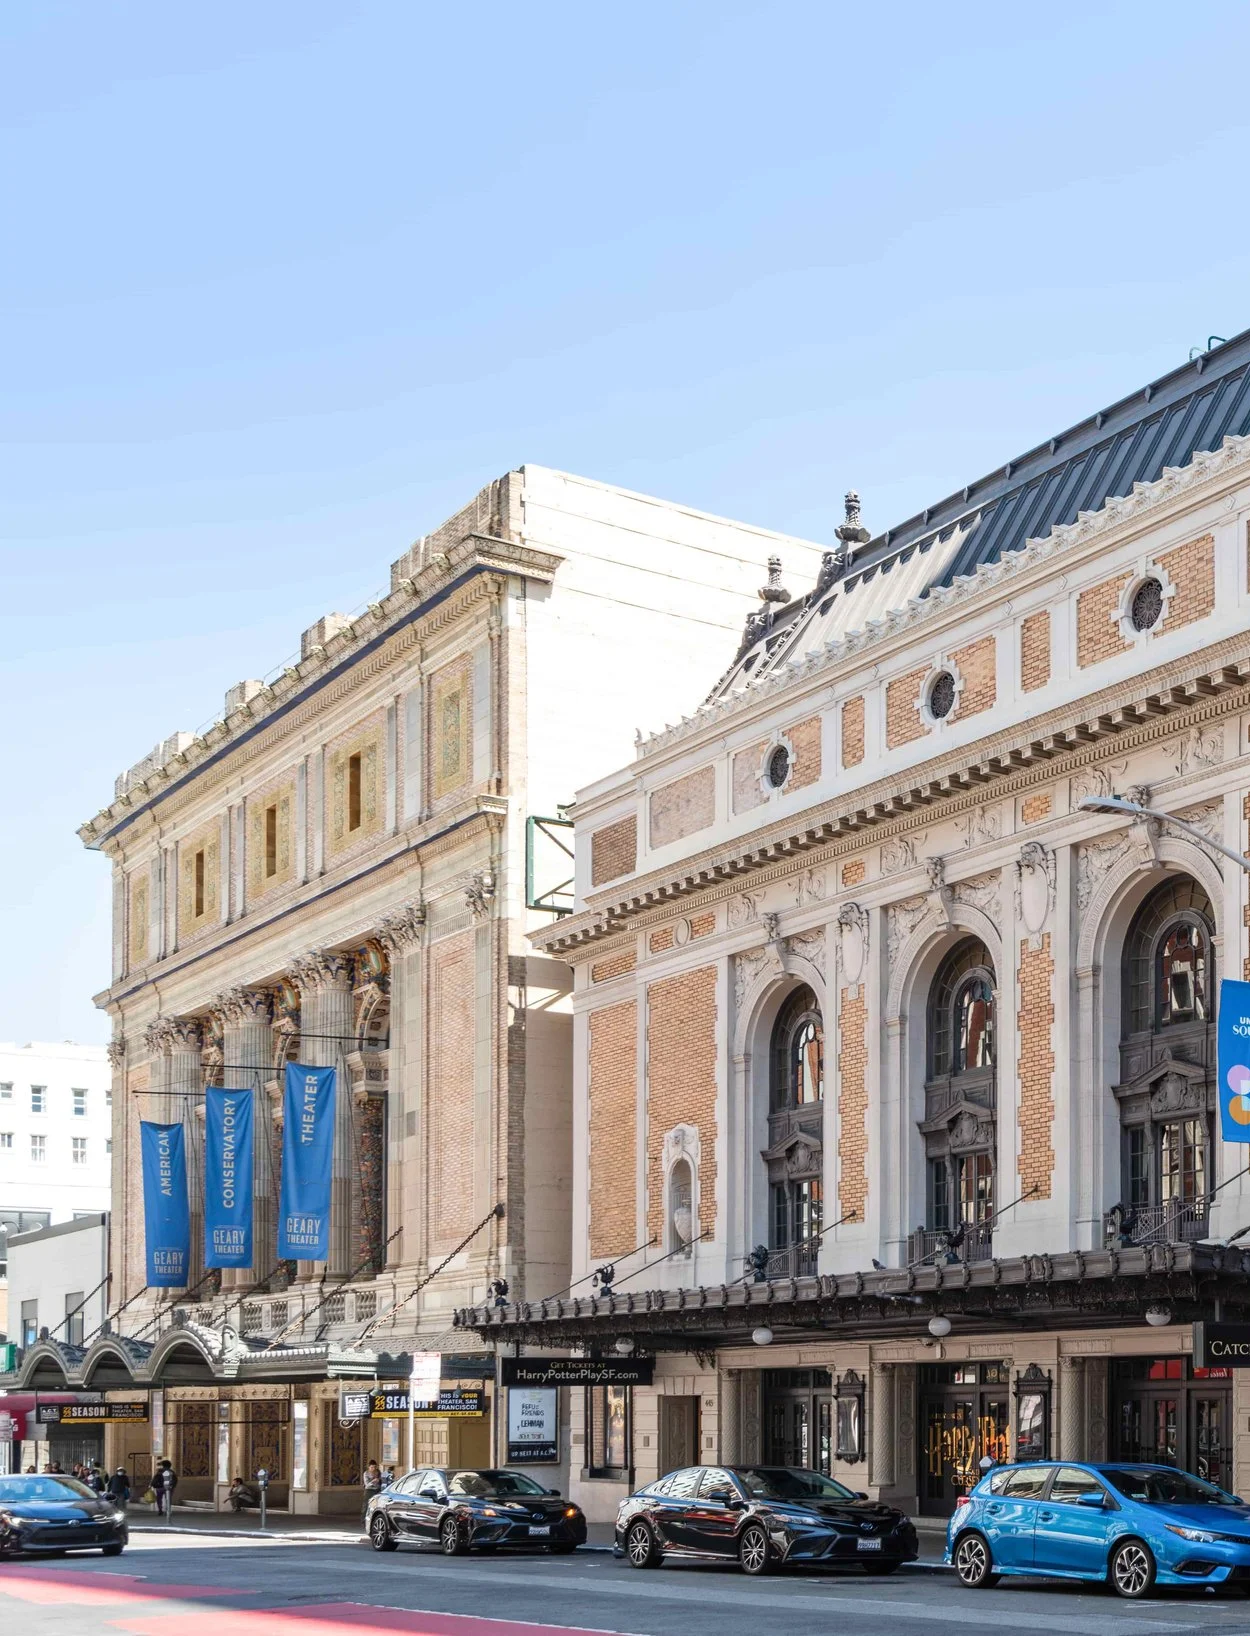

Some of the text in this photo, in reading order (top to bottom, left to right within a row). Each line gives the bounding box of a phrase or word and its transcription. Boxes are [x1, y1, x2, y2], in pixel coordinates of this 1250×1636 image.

[301, 1074, 319, 1144] THEATER
[223, 1097, 237, 1209] CONSERVATORY
[159, 1130, 173, 1197] AMERICAN
[287, 1217, 320, 1234] GEARY
[213, 1229, 245, 1244] GEARY
[287, 1234, 319, 1245] THEATER
[214, 1244, 245, 1254] THEATER
[153, 1251, 184, 1265] GEARY
[155, 1265, 183, 1274] THEATER
[516, 1368, 639, 1383] HarryPotterPlaySF.com
[71, 1406, 109, 1417] SEASON!
